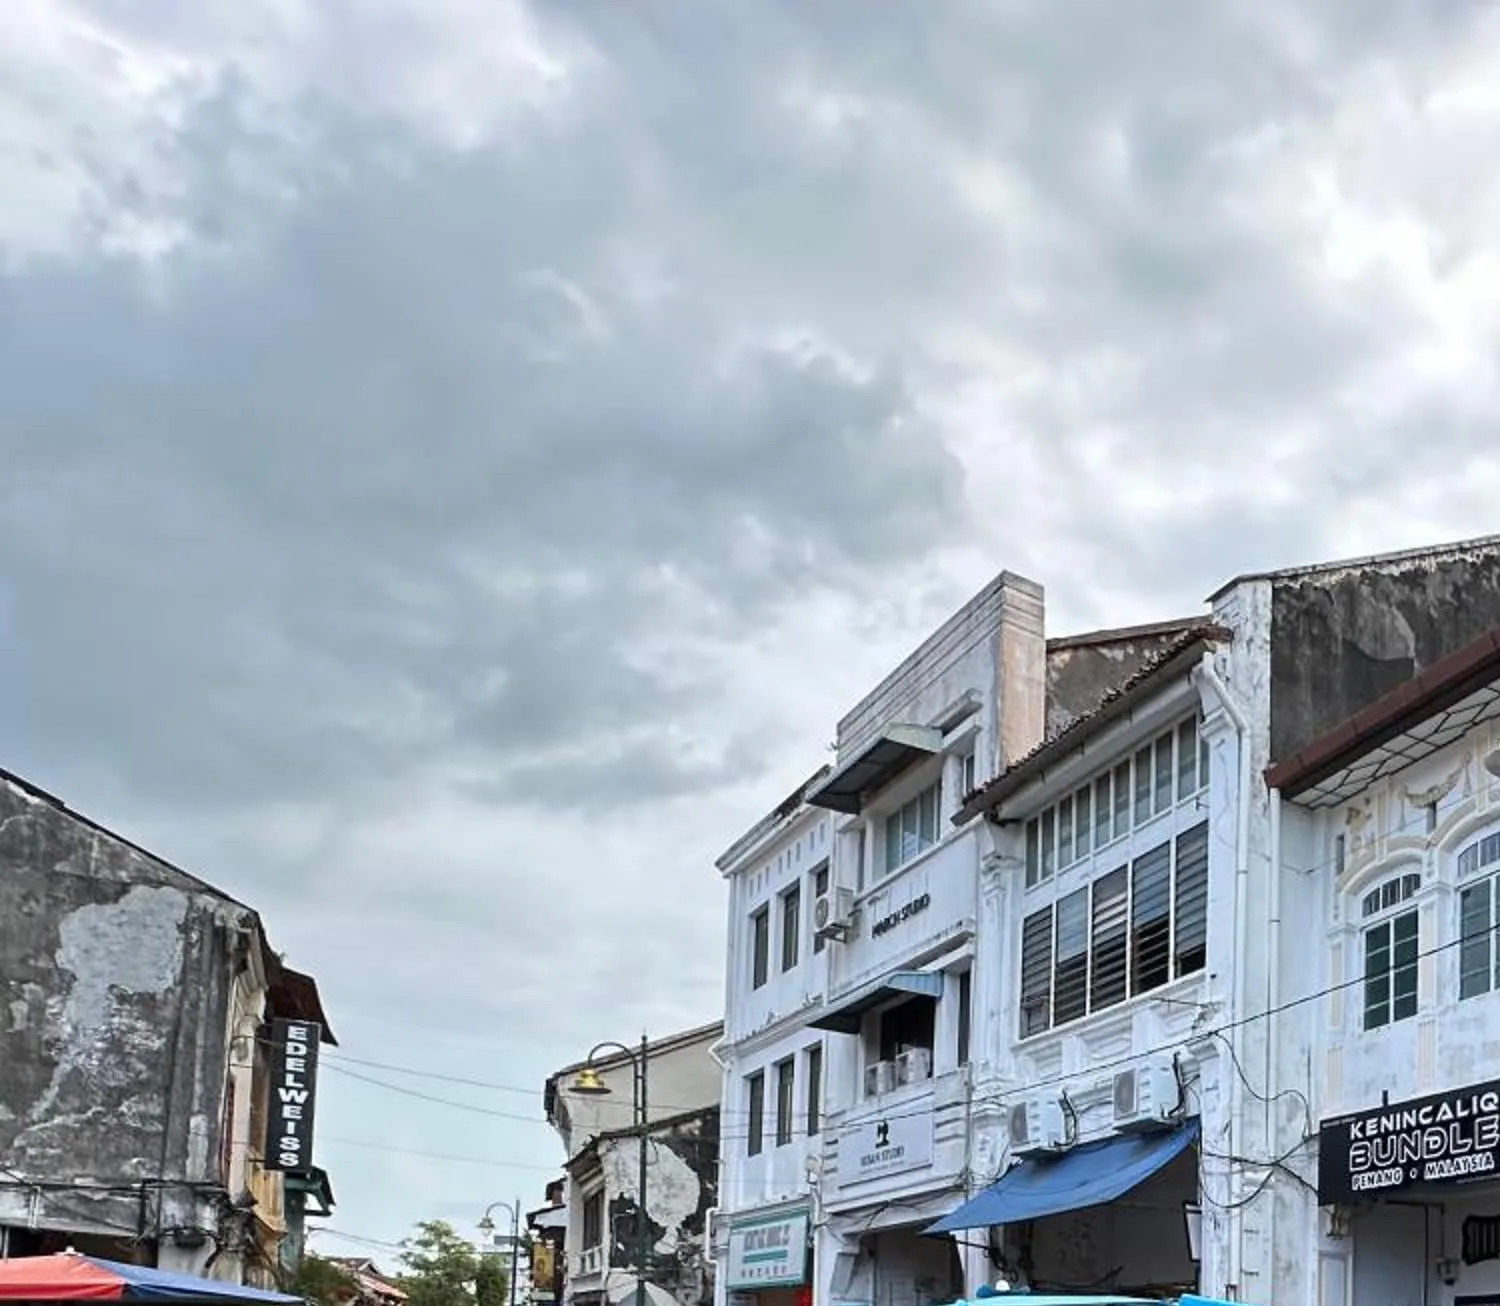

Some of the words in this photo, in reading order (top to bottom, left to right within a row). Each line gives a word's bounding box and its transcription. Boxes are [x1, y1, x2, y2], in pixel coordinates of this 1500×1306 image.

[277, 1025, 309, 1167] EDELWEISS
[1350, 1091, 1500, 1141] KENINCALIQ
[1349, 1113, 1500, 1172] BUNDLE
[1351, 1167, 1404, 1191] PENANG
[1423, 1151, 1496, 1181] MALAYSIA
